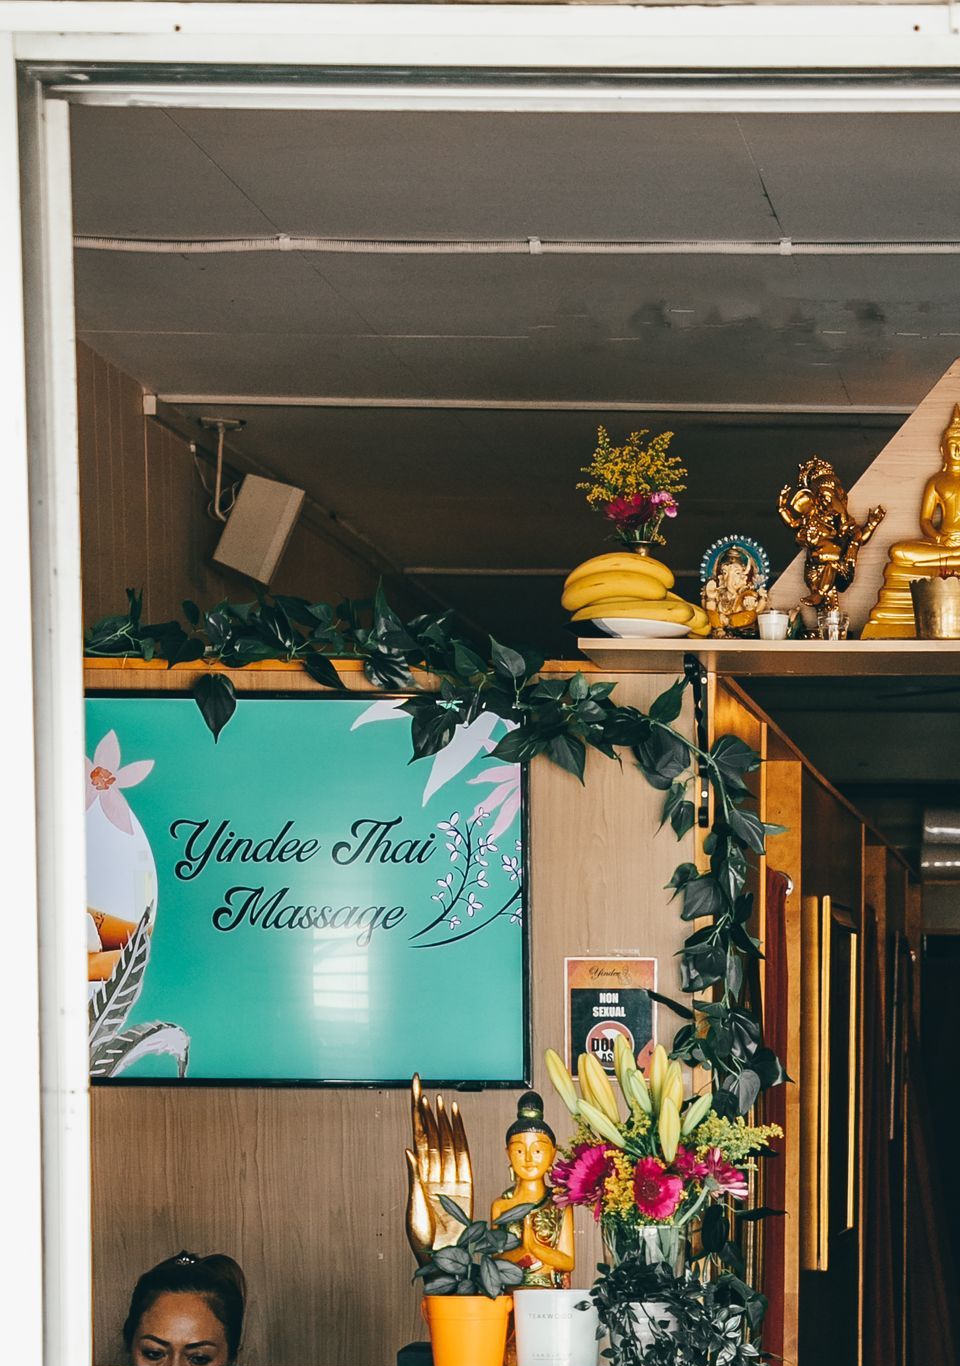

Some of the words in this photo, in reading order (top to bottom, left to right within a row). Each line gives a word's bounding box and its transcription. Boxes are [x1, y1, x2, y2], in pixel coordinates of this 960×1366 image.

[169, 818, 321, 881] Yindee
[331, 816, 437, 866] Thai
[212, 886, 407, 947] Massage
[599, 992, 619, 1004] NON
[592, 1006, 627, 1018] SEXUAL
[601, 1052, 614, 1063] AS
